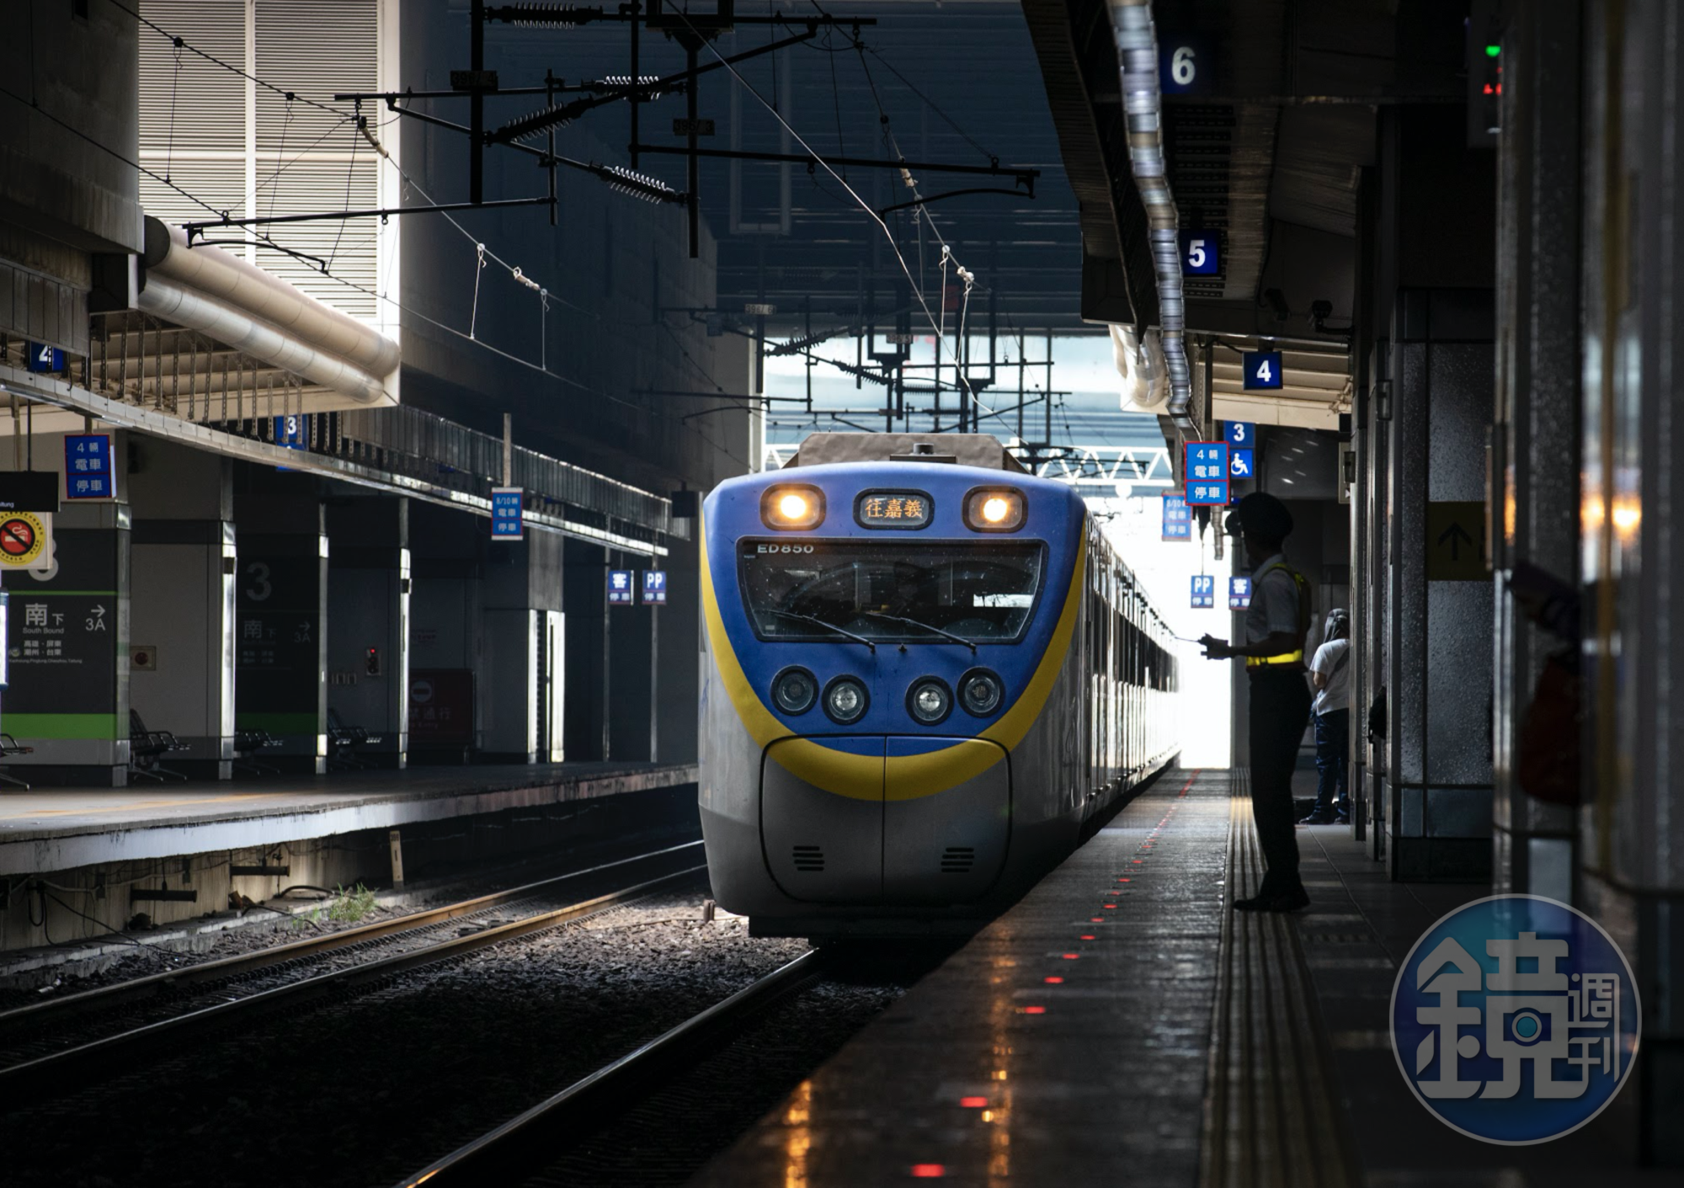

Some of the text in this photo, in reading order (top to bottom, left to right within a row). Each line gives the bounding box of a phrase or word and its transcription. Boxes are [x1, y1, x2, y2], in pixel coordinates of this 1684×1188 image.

[1171, 46, 1196, 85] 6
[1188, 239, 1206, 267] 5
[1256, 360, 1272, 382] 4
[1233, 423, 1245, 442] 3
[76, 479, 103, 493] 停車
[1194, 486, 1220, 499] 停車
[865, 498, 923, 519] 往嘉義
[757, 543, 814, 554] ED850
[246, 562, 272, 601] 3
[646, 573, 663, 589] PP
[1194, 577, 1211, 593] PP
[85, 618, 106, 631] 3A
[293, 631, 311, 643] 3A
